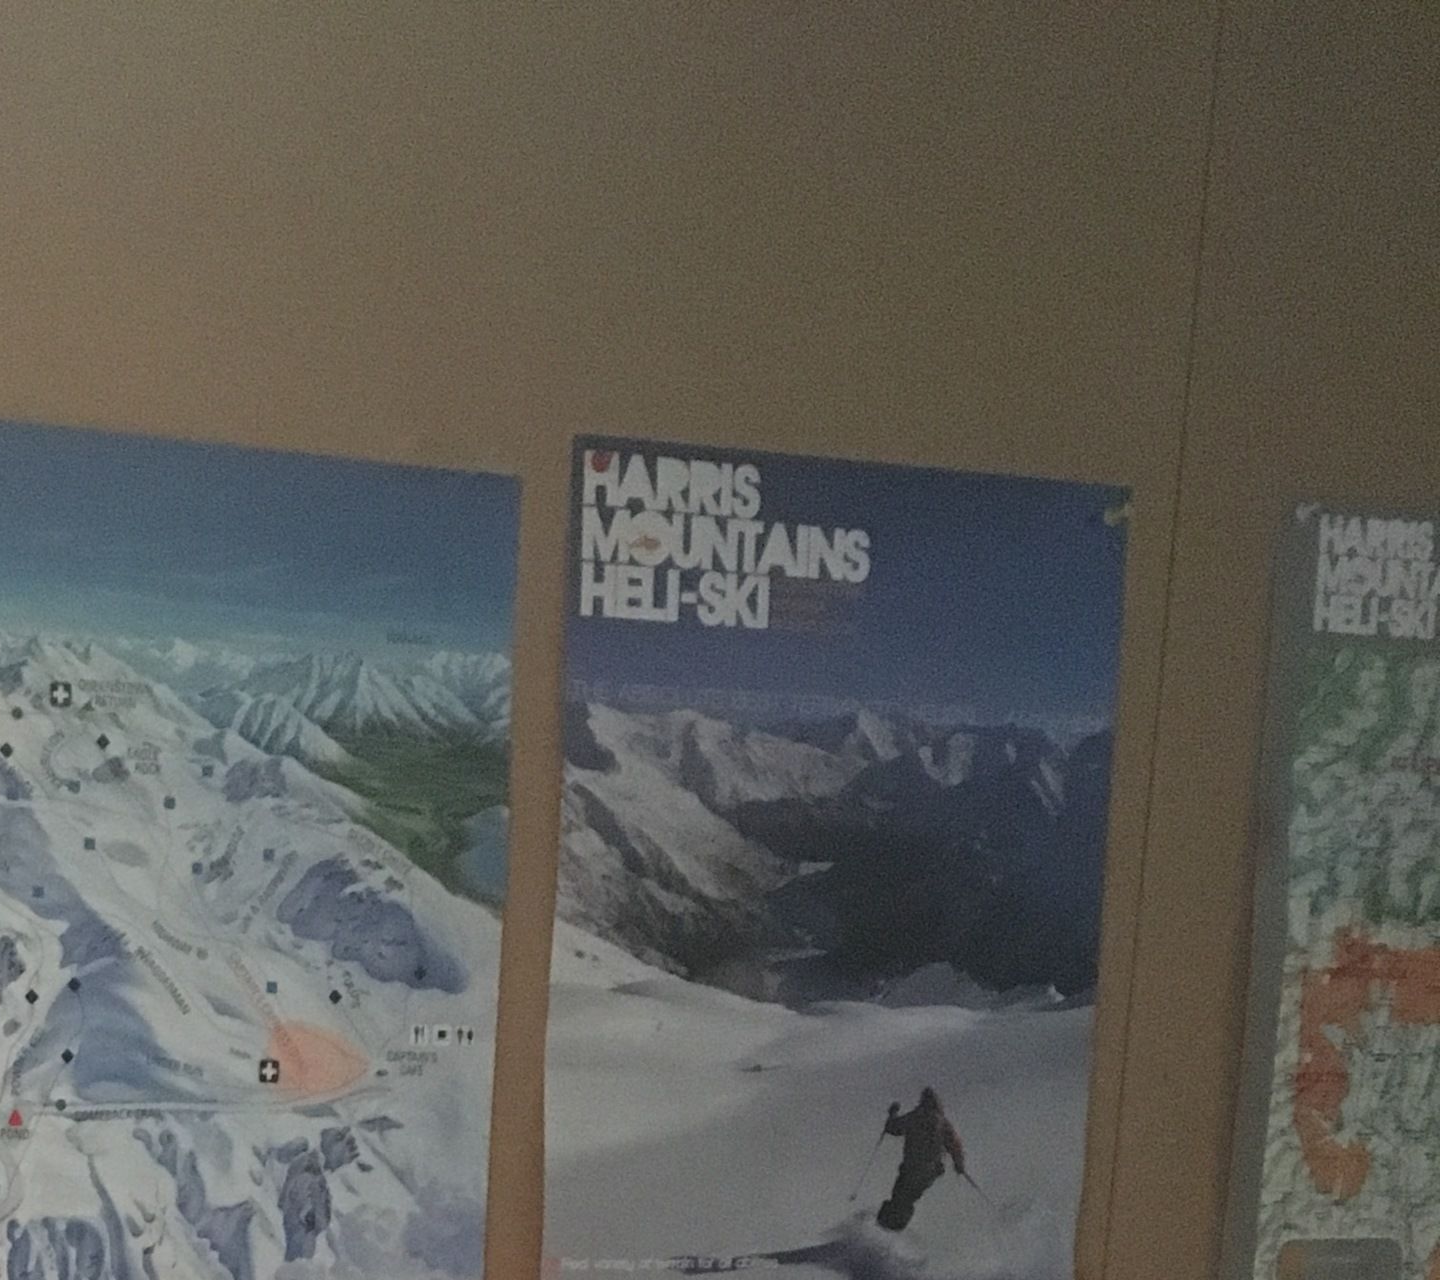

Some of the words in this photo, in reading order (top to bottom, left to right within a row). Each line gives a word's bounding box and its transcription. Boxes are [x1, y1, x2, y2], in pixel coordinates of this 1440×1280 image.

[582, 448, 762, 520] HARRIS
[581, 505, 872, 583] MOUNTAINS
[1318, 513, 1434, 563] HARRIS
[579, 560, 771, 630] HELI-SKI
